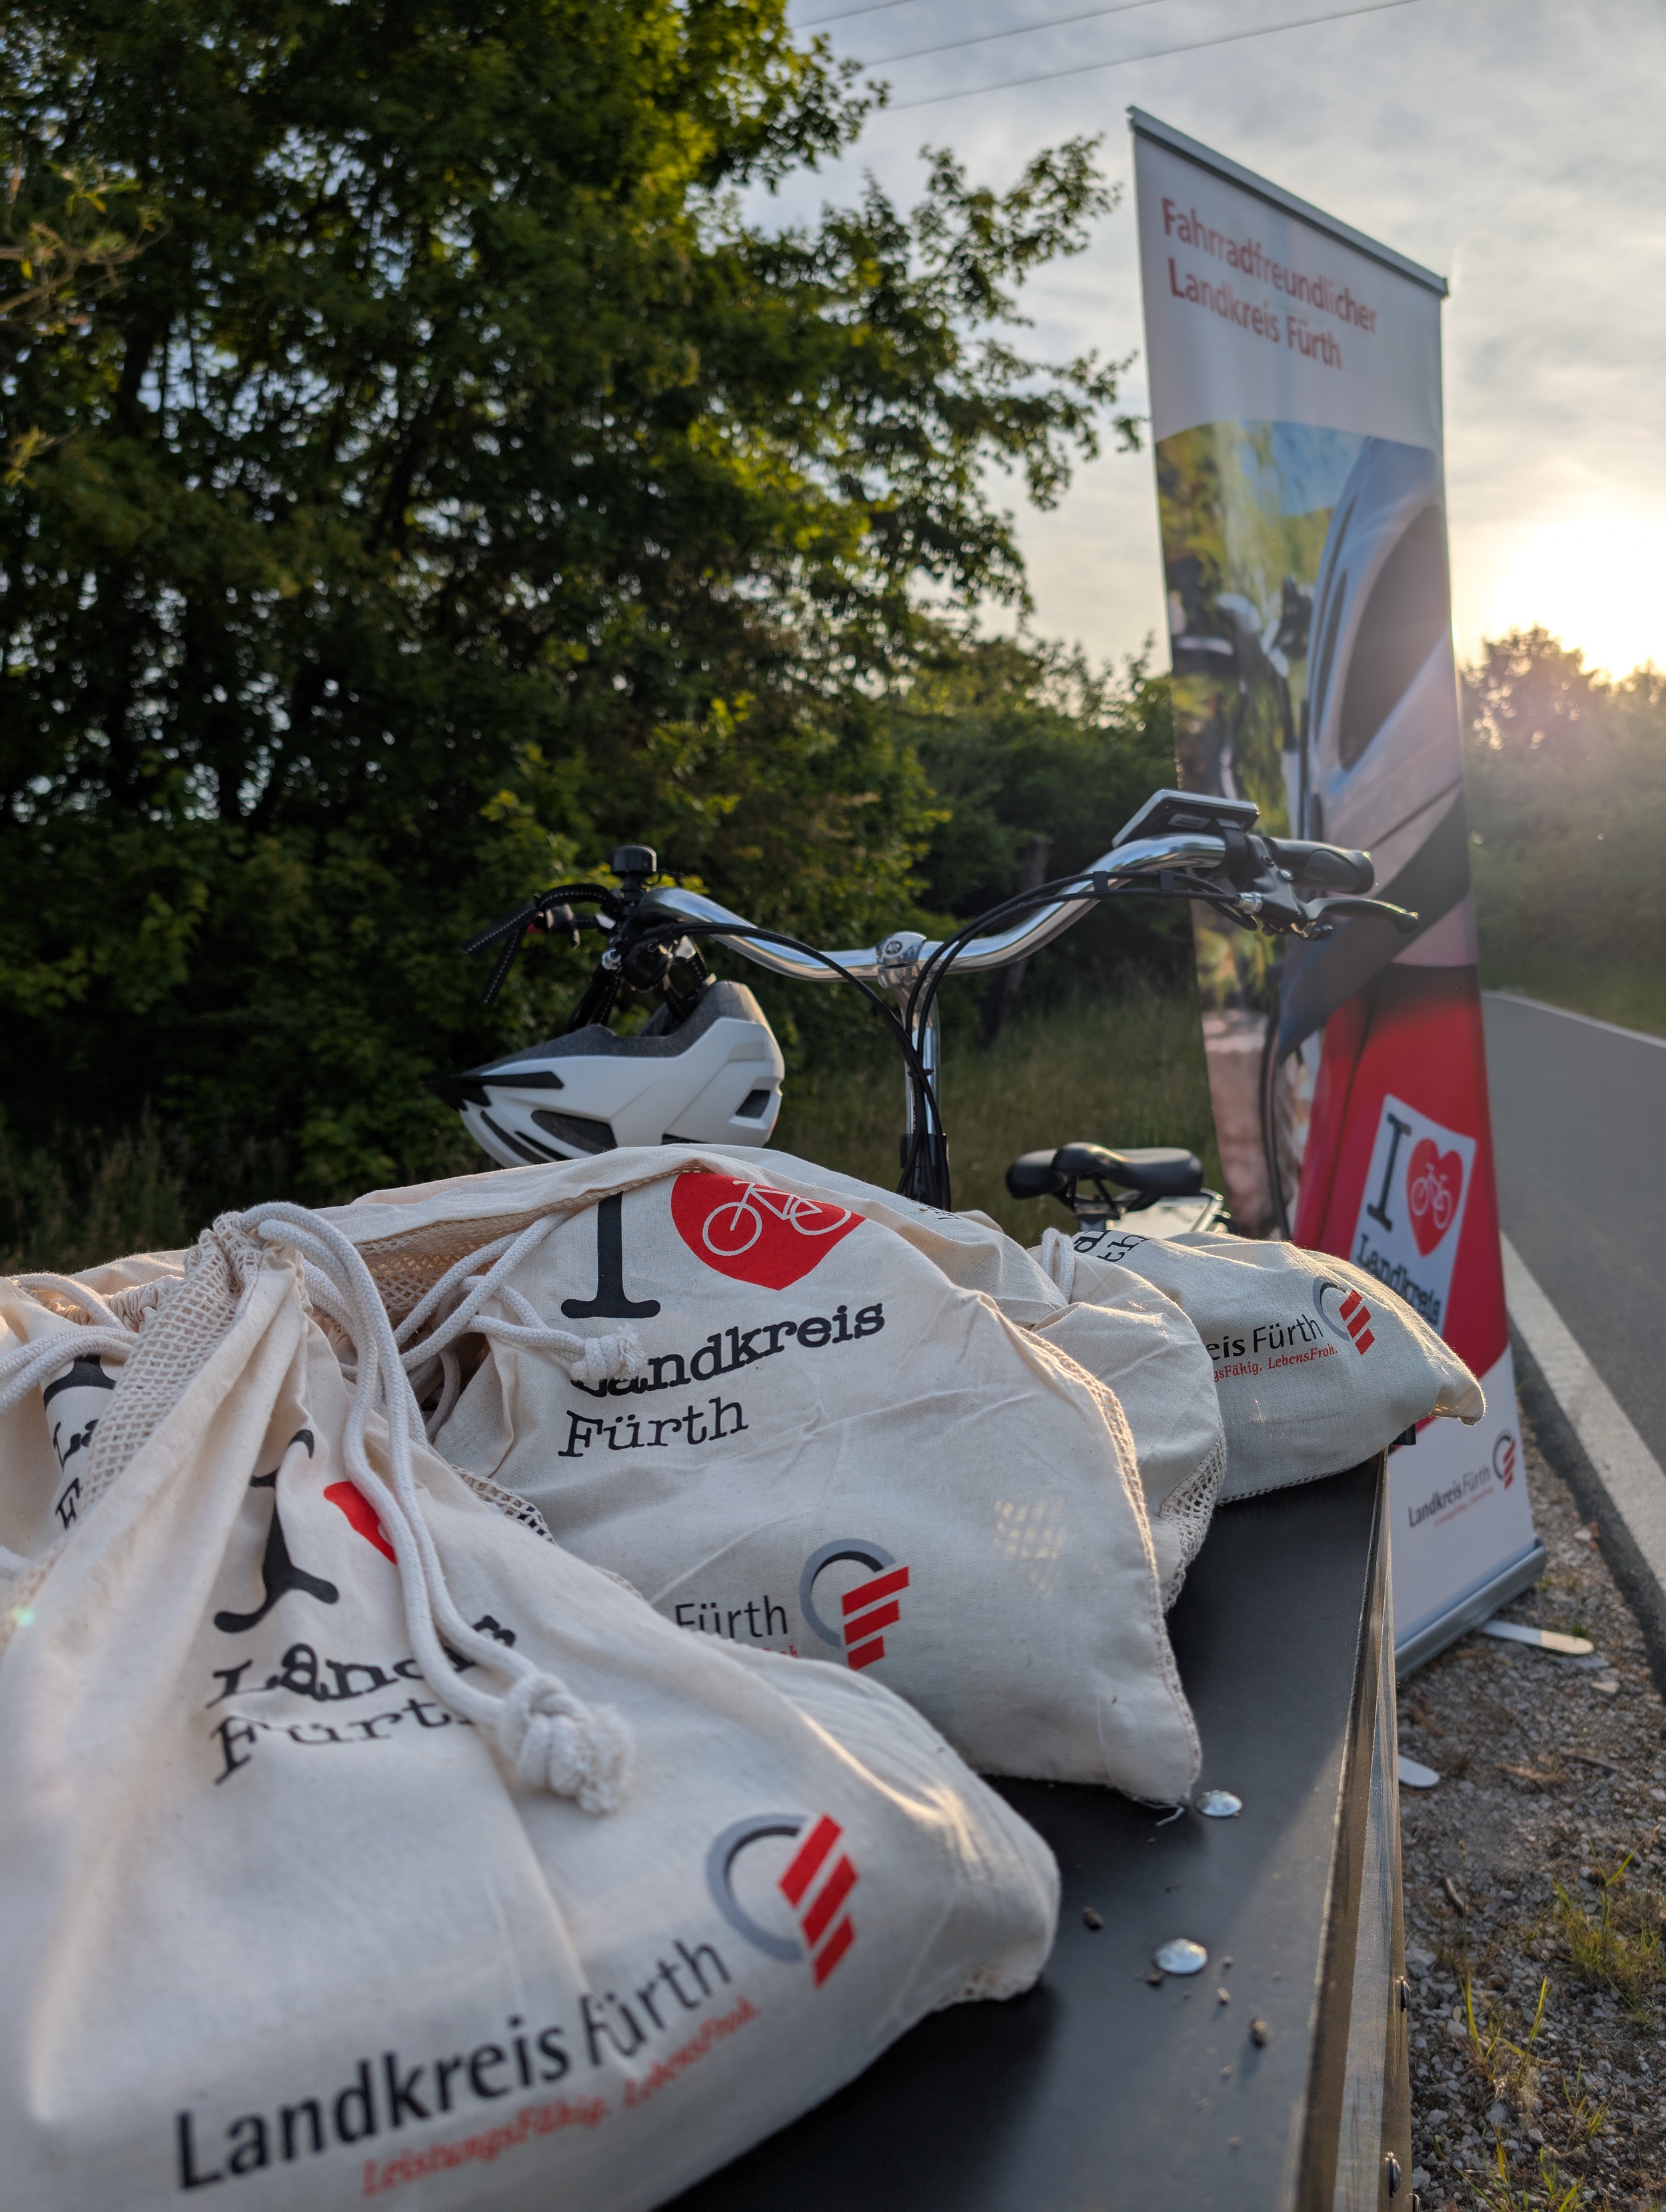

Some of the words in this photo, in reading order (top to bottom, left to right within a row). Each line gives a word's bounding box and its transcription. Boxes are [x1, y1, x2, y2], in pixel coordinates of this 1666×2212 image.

[1162, 197, 1377, 333] Fahrradfreundlicher
[1168, 257, 1281, 344] Landkreis
[1286, 314, 1343, 370] Fürth
[1253, 1313, 1324, 1353] Fürth
[1267, 1343, 1339, 1369] LebensFroh.
[558, 1396, 749, 1458] Fürth
[675, 1594, 788, 1639] Fürth
[211, 1698, 474, 1786] Fürt
[175, 2013, 571, 2192] Landkreis
